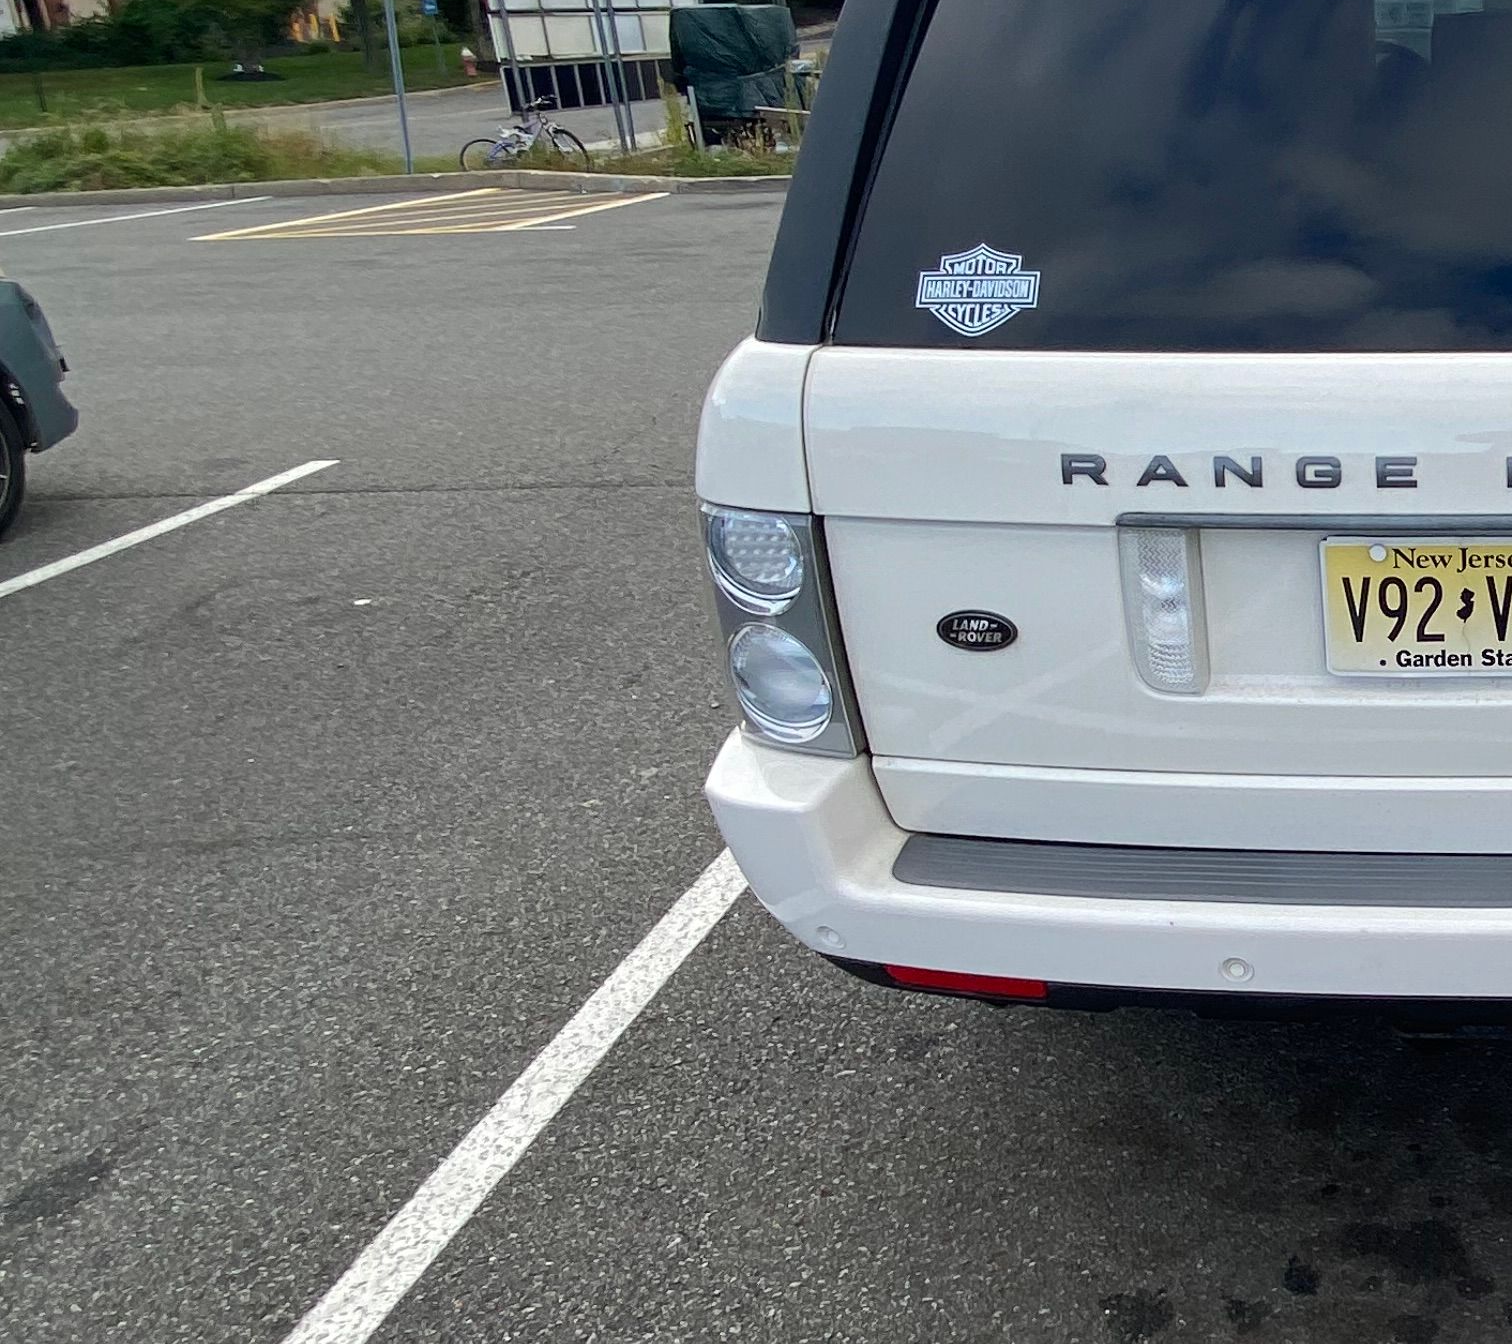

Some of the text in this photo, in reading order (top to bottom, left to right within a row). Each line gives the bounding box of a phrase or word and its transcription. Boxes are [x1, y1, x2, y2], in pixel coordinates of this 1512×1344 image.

[953, 255, 1008, 275] MOTOR
[926, 280, 1030, 298] HARLEY-DAVIDSON
[946, 303, 1003, 327] CYCLES
[1060, 452, 1418, 489] RANGE
[1391, 547, 1453, 569] New
[1341, 576, 1446, 643] V92
[1395, 649, 1473, 668] Garden
